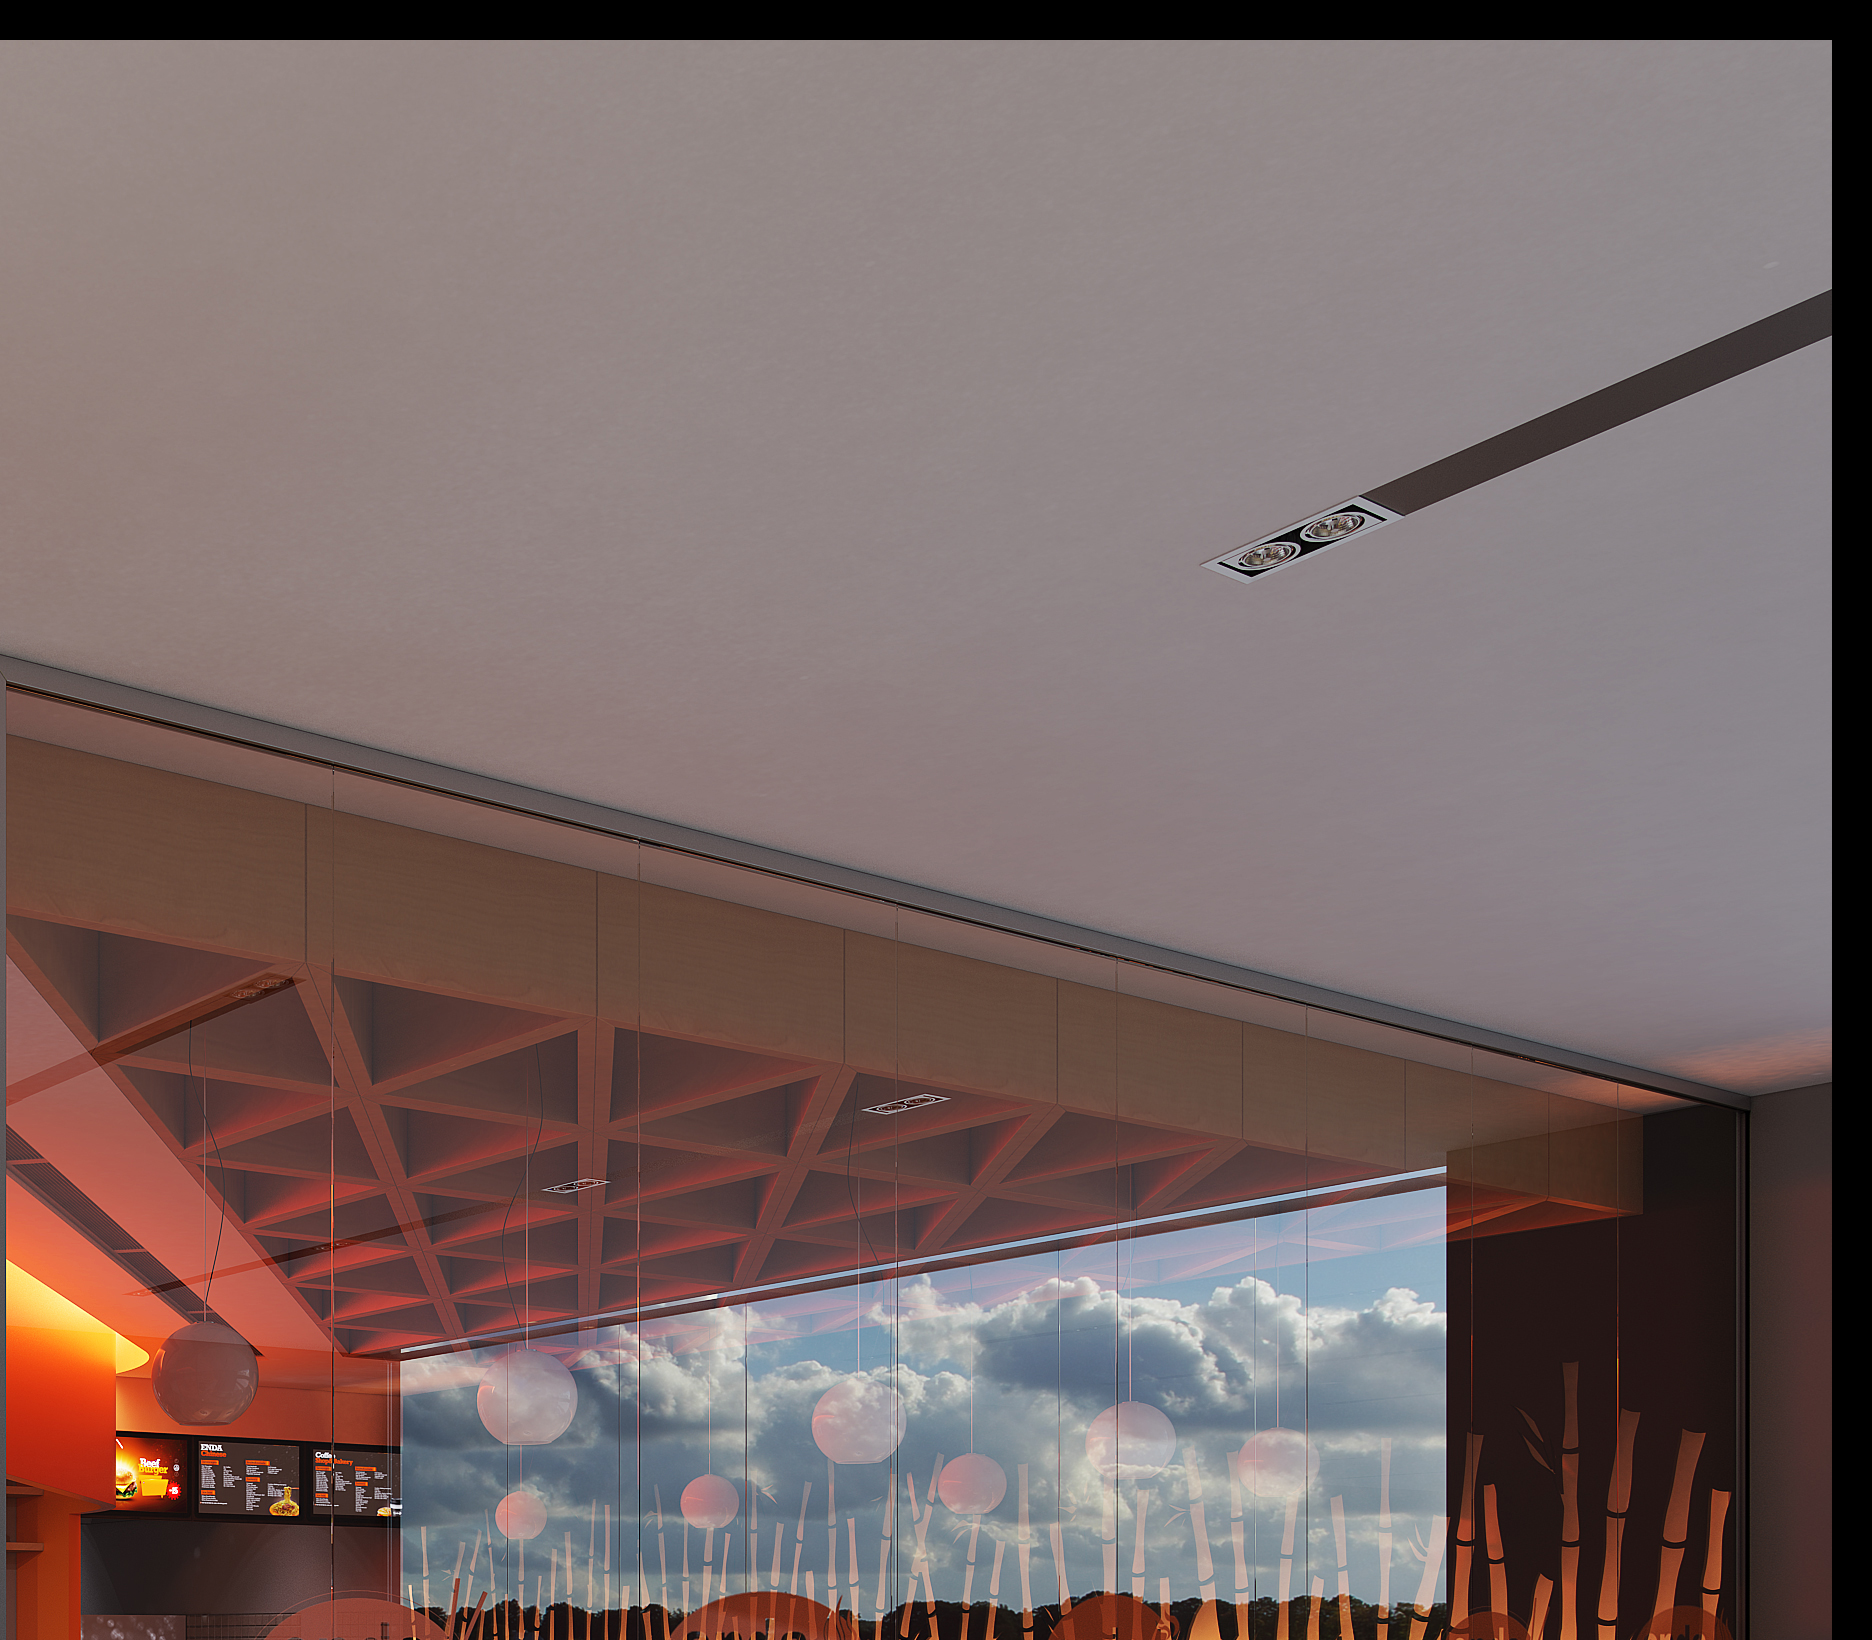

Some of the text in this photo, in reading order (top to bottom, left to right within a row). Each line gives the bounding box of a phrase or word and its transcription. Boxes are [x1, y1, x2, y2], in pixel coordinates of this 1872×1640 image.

[200, 1443, 223, 1451] ENDA
[139, 1457, 161, 1468] Beef
[138, 1463, 168, 1476] Burger
